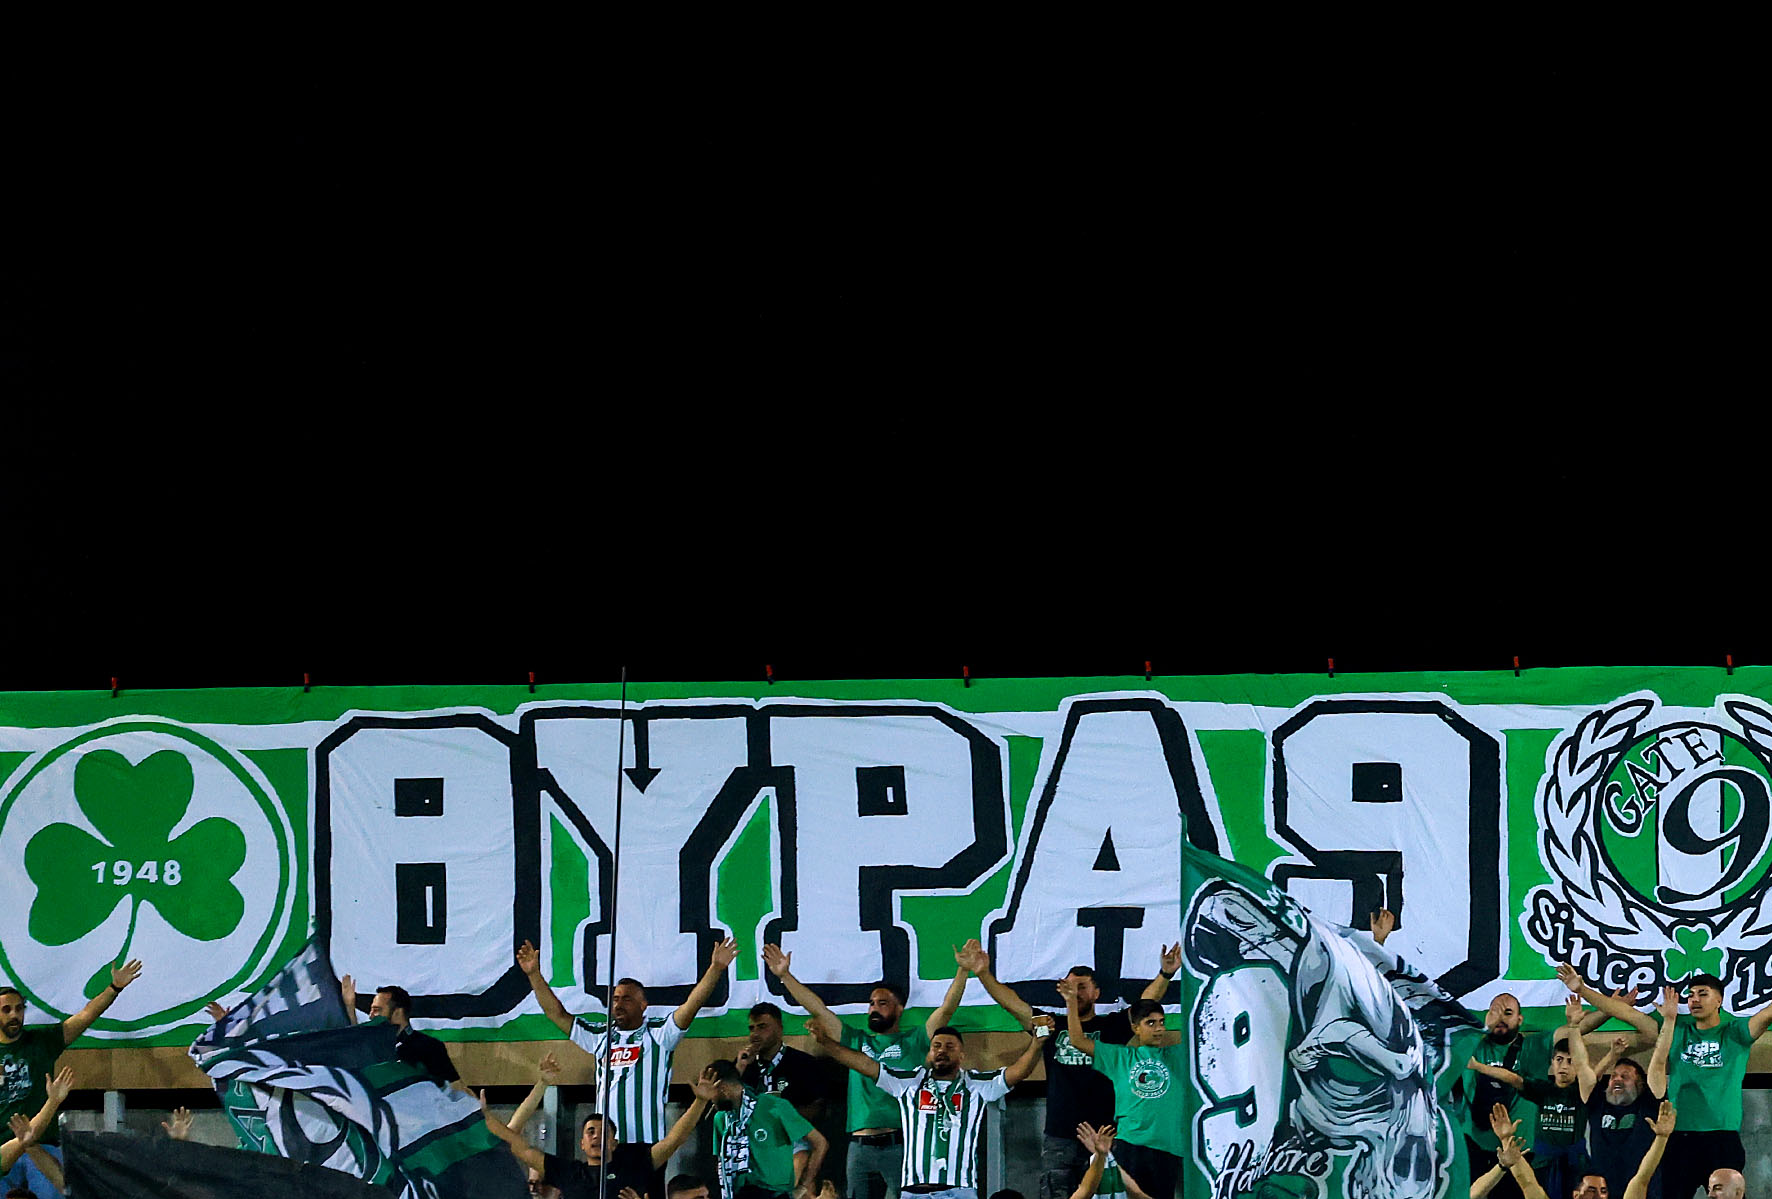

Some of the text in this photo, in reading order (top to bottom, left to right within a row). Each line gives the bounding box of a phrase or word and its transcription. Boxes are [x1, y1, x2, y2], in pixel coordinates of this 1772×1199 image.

[1604, 727, 1725, 836] GATE
[91, 859, 184, 887] 1948
[316, 698, 1224, 1018] ΘΥΡΑ
[1272, 698, 1501, 1003] 9
[1656, 768, 1771, 905] 9
[1531, 893, 1658, 1000] Since
